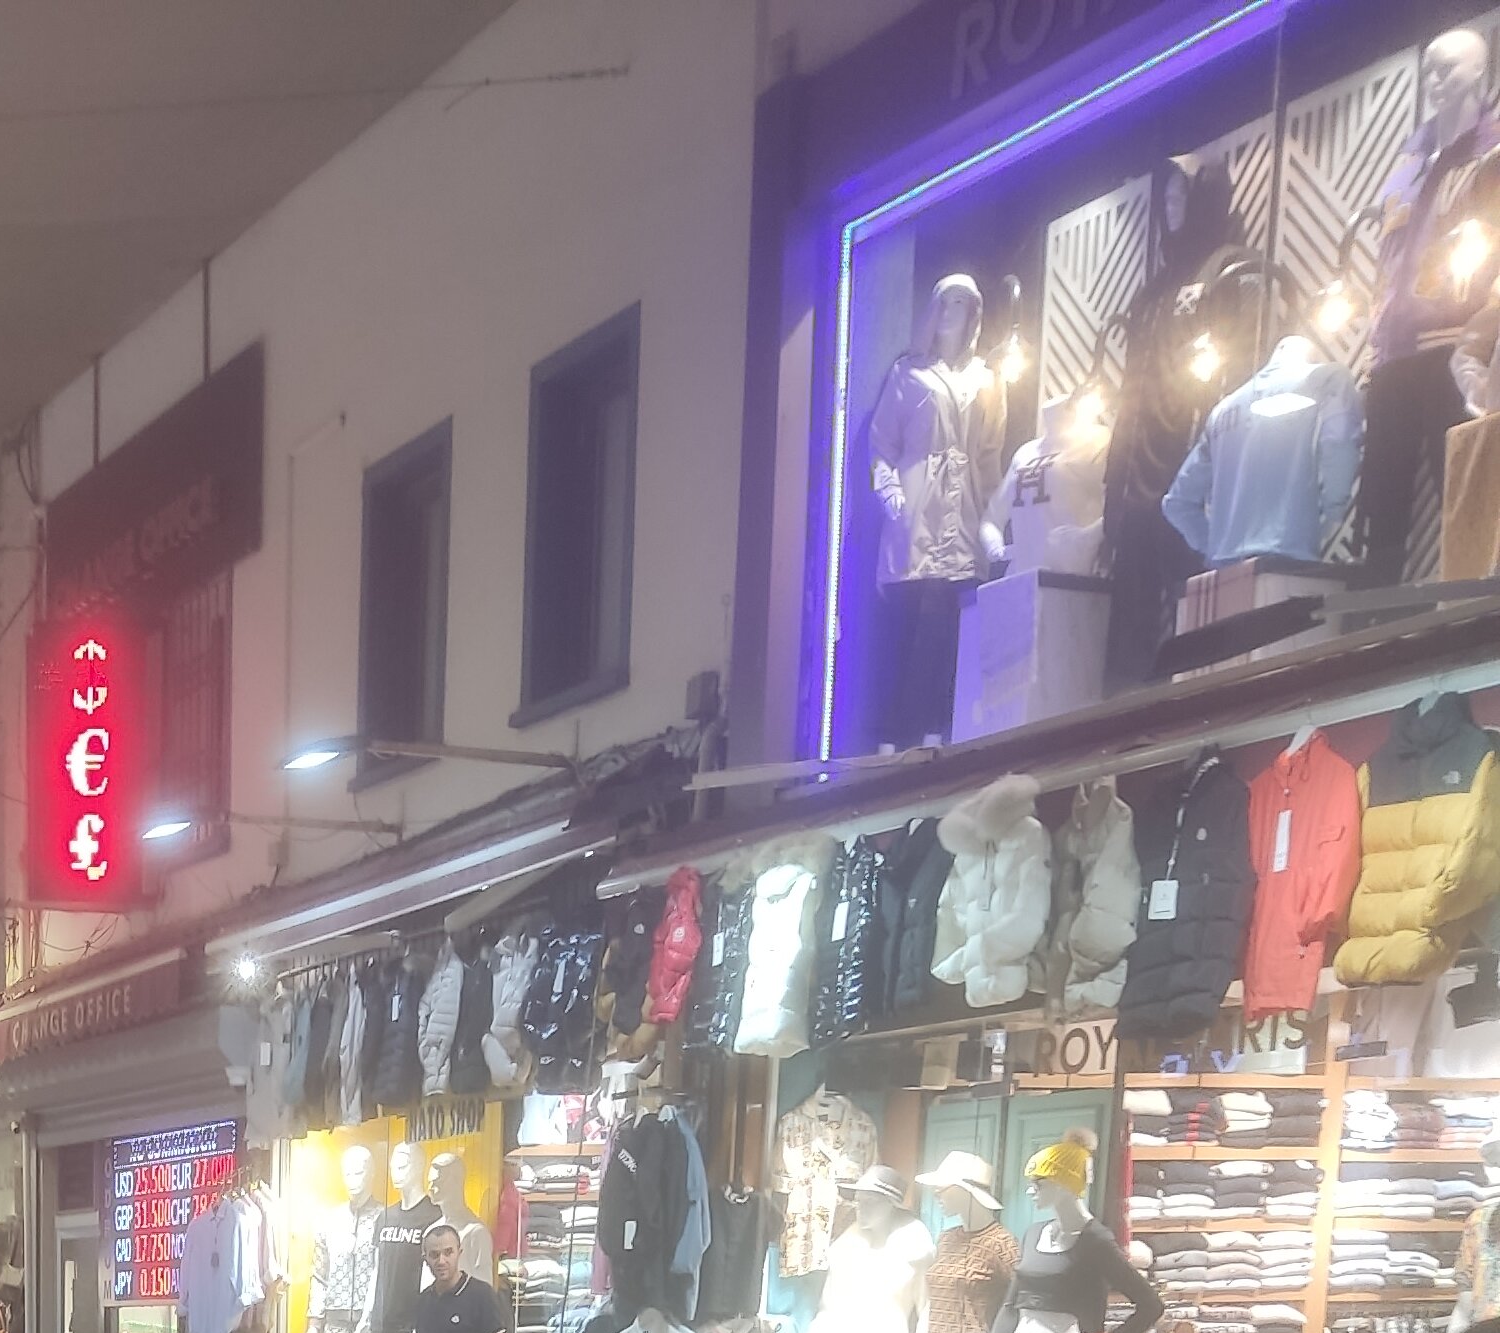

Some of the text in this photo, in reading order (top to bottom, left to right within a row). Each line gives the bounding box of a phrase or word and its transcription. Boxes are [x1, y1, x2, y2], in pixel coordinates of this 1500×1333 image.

[12, 984, 132, 1049] CHANGE OFFICE
[114, 1171, 134, 1199] USD
[134, 1163, 172, 1197] 25.500
[172, 1162, 193, 1191] EUR
[114, 1204, 134, 1231] GBP
[134, 1199, 171, 1230] 31.500
[171, 1196, 192, 1226] CHF
[115, 1238, 132, 1263] CAD
[134, 1232, 171, 1263] 17.750
[379, 1226, 422, 1244] CELINE
[115, 1271, 133, 1296] JPY
[139, 1267, 171, 1297] 0.150
